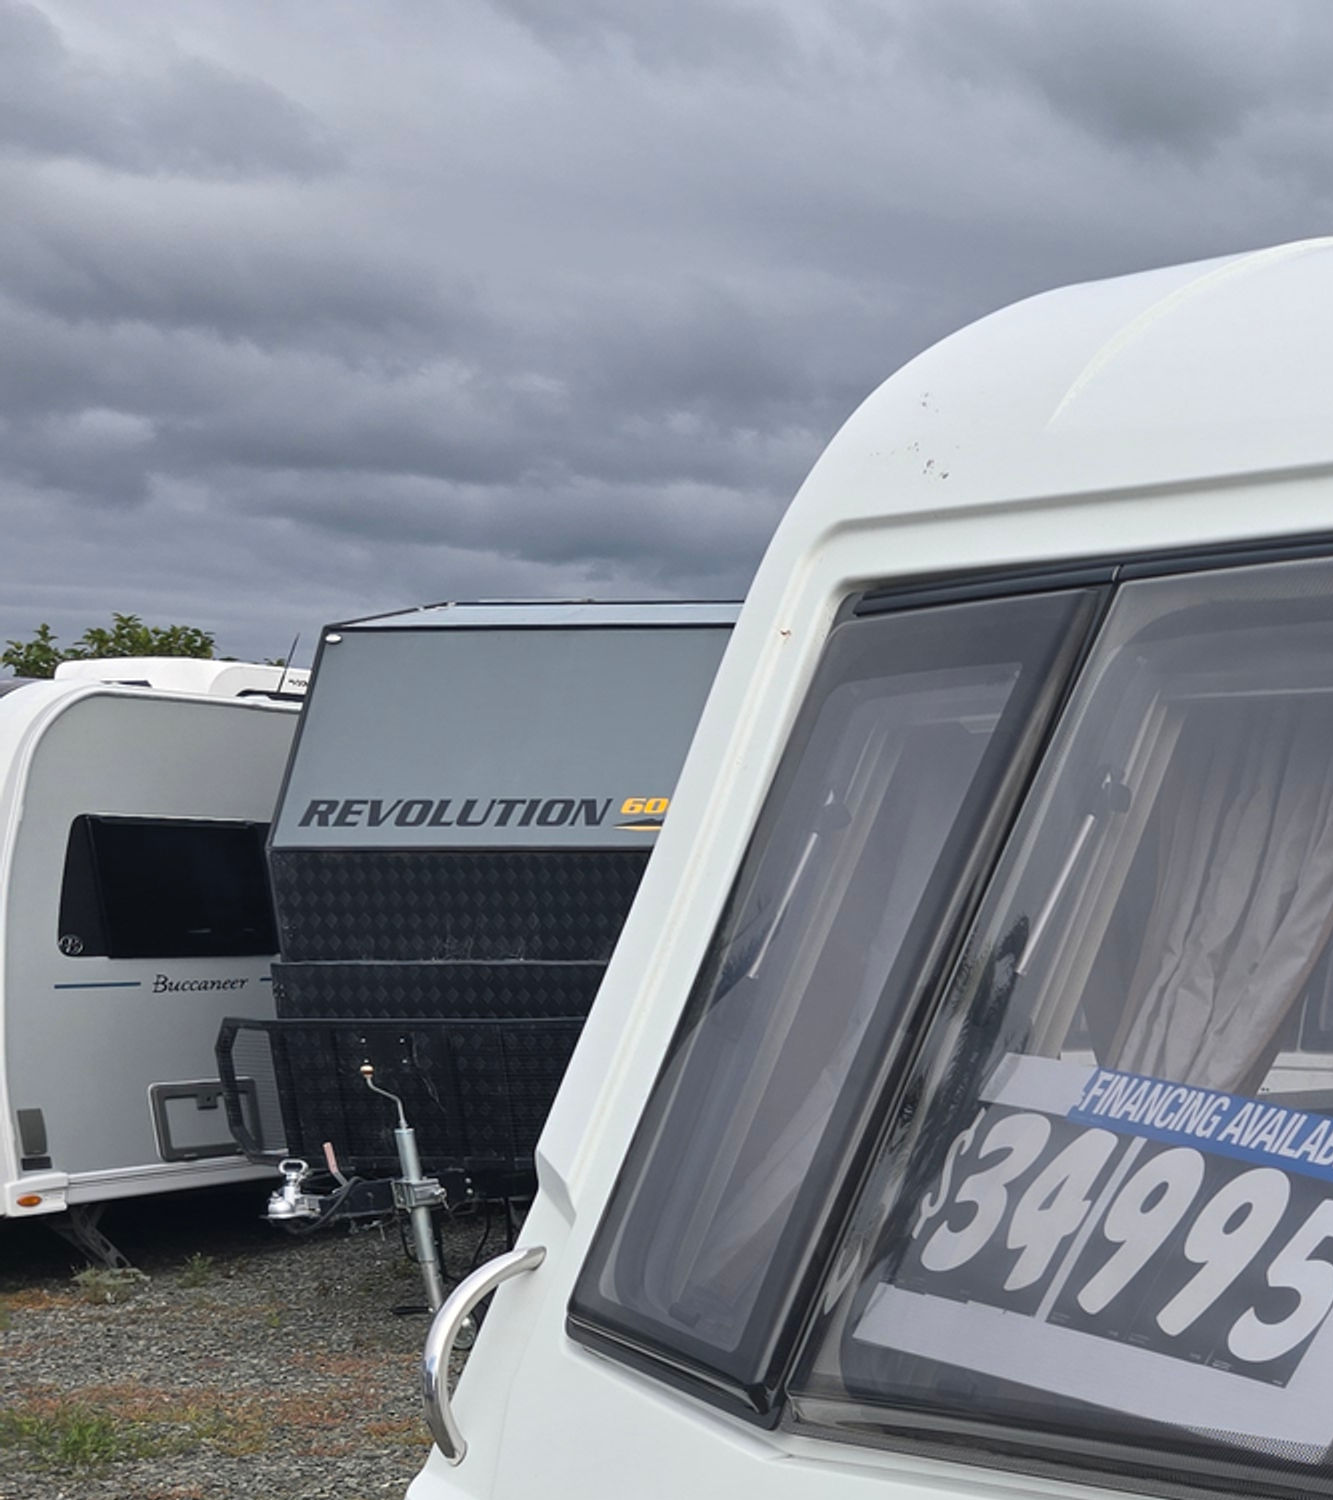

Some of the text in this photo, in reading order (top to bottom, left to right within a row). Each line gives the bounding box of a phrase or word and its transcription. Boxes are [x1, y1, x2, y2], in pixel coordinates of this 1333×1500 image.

[298, 798, 613, 827] REVOLUTION
[152, 974, 249, 994] Buccaneer
[1079, 1070, 1231, 1139] FINANCING
